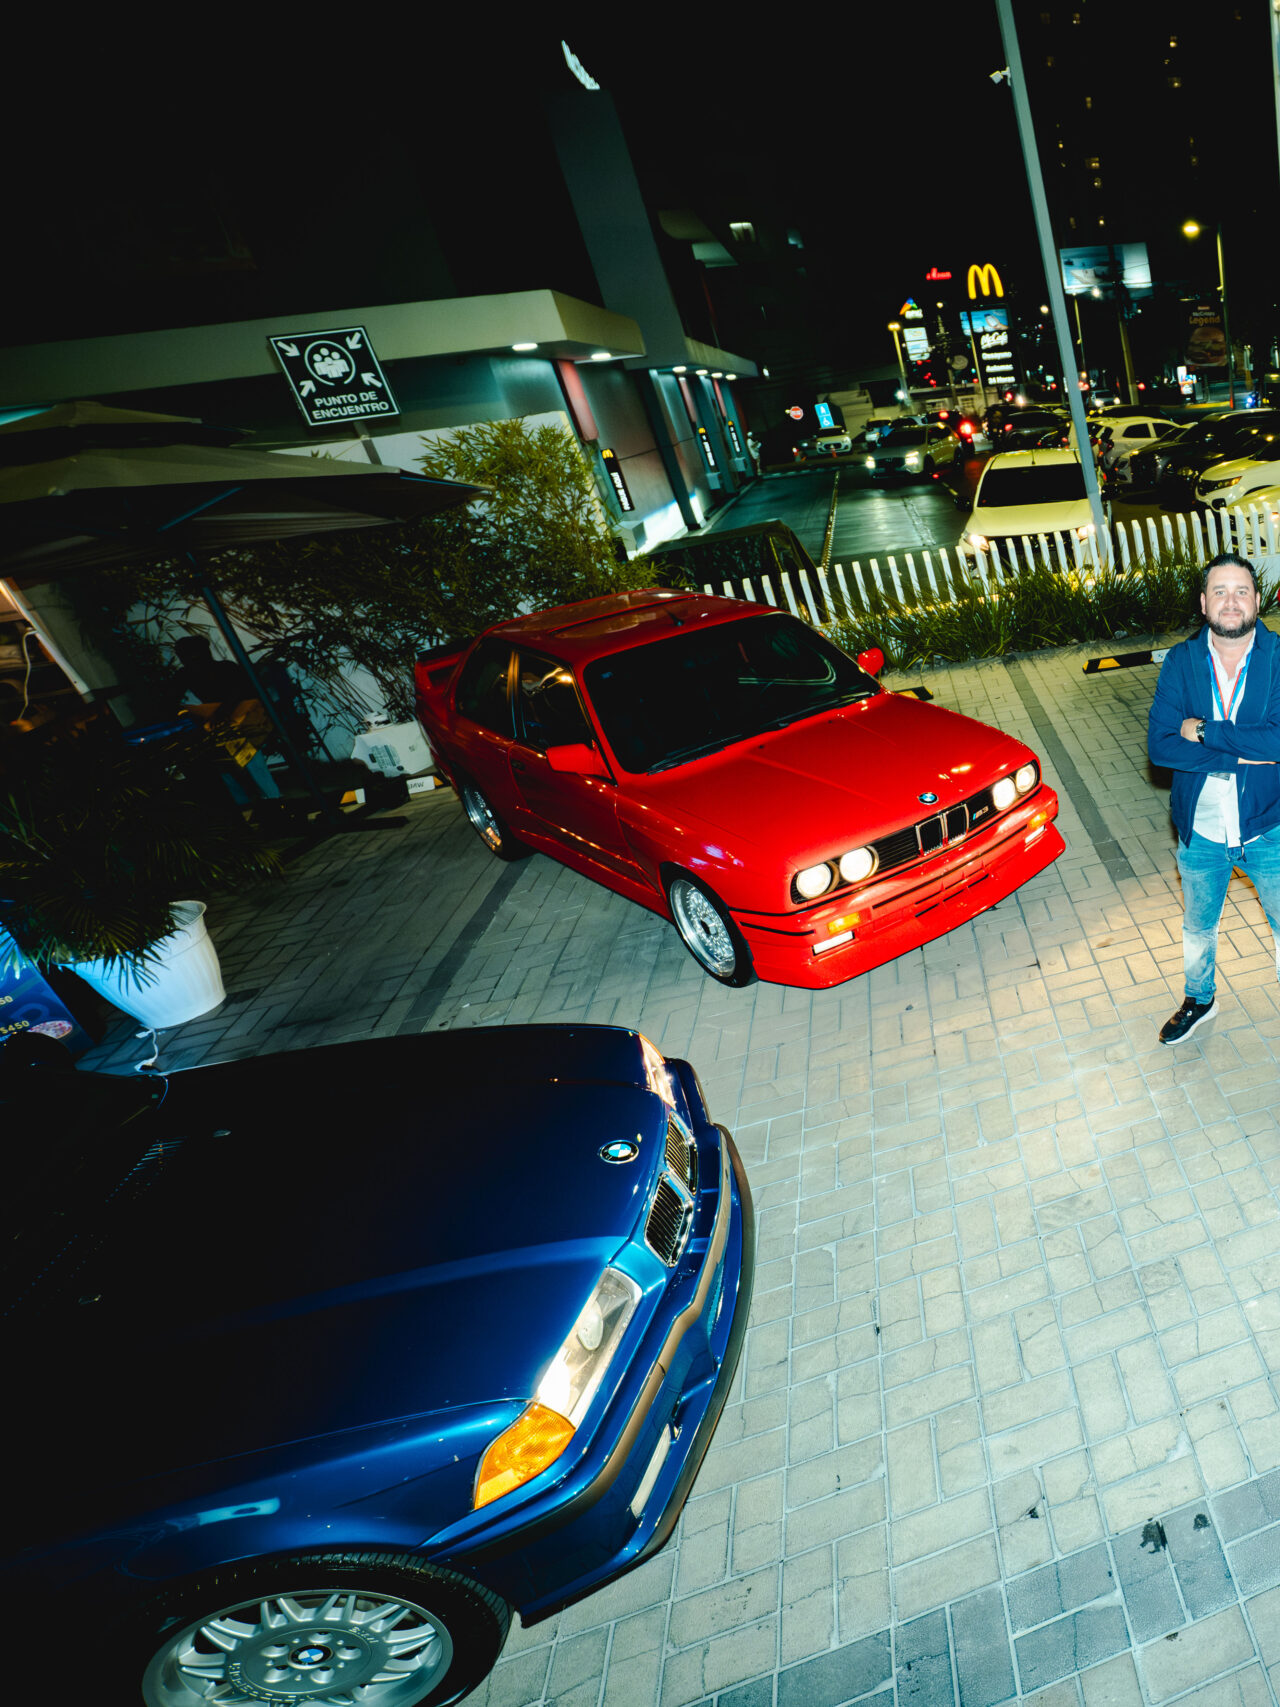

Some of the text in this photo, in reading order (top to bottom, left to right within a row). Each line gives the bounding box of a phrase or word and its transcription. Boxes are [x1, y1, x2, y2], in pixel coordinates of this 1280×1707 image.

[314, 391, 379, 408] PUNTO DE
[312, 401, 390, 420] ENCUENTRO
